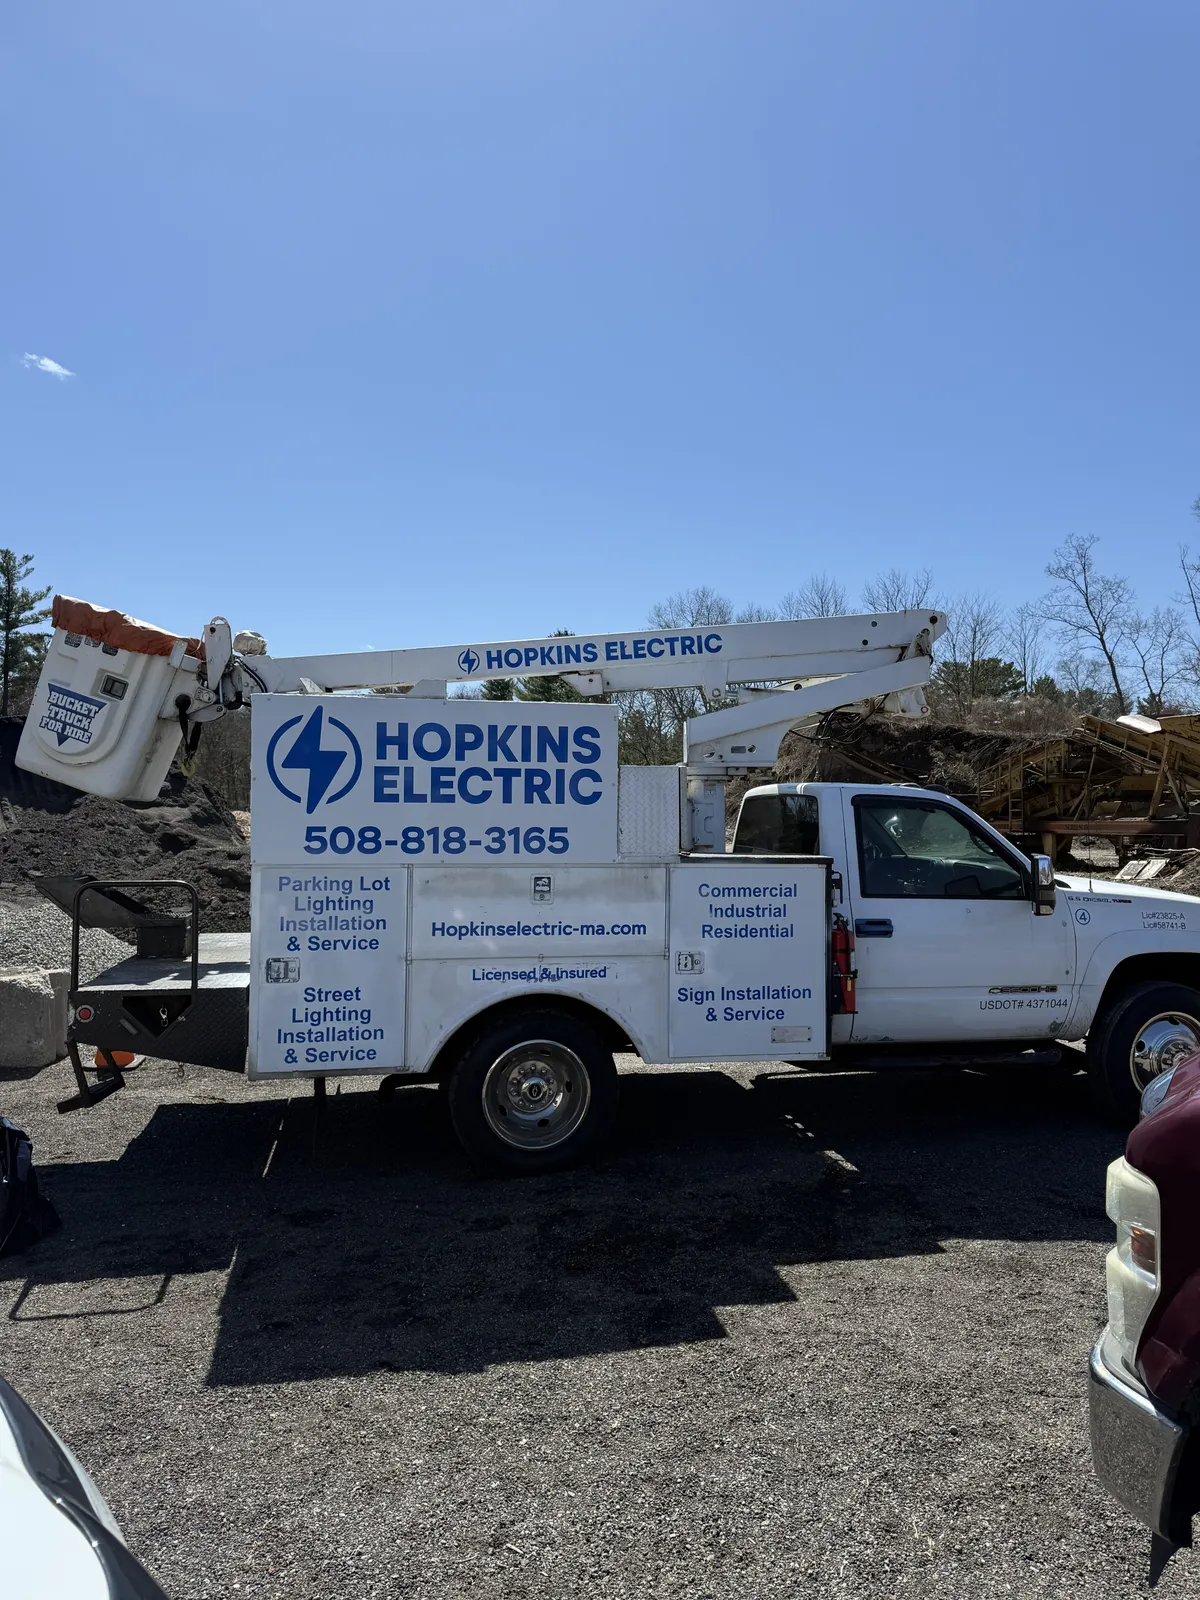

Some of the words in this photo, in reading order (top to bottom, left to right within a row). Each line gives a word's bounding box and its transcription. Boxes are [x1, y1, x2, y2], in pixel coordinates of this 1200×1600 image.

[486, 642, 598, 669] HOPKINS
[605, 633, 723, 661] ELECTRIC
[48, 691, 99, 717] BUCKET
[49, 705, 92, 728] TRUCK
[40, 717, 62, 733] FOR
[64, 726, 91, 743] HIRE
[375, 722, 601, 764] HOPKINS
[373, 766, 603, 805] ELECTRIC
[303, 826, 570, 855] 508-818-3165
[278, 876, 353, 894] Parking
[360, 876, 390, 891] Lot
[698, 883, 797, 898] Commercial
[294, 896, 374, 914] Lighting
[709, 904, 787, 918] Industrial
[280, 916, 387, 932] Installation
[1141, 911, 1185, 920] Lic#23825-A
[432, 921, 647, 940] Hopkinselectric-ma.com
[701, 924, 794, 939] Residential
[1143, 921, 1186, 930] Lic#58741-B
[286, 936, 301, 951] &
[308, 935, 380, 951] Service
[472, 968, 536, 981] Licensed
[540, 967, 553, 981] &
[556, 966, 607, 979] Insured
[303, 987, 361, 1003] Street
[677, 987, 715, 1005] Sign
[721, 985, 812, 1001] Installation
[980, 1000, 1024, 1010] USDOT#
[1026, 999, 1068, 1009] 4371044
[291, 1007, 371, 1026] Lighting
[705, 1007, 718, 1022] &
[723, 1006, 785, 1021] Service
[277, 1026, 384, 1044] Installation
[284, 1048, 299, 1064] &
[305, 1046, 377, 1063] Service
